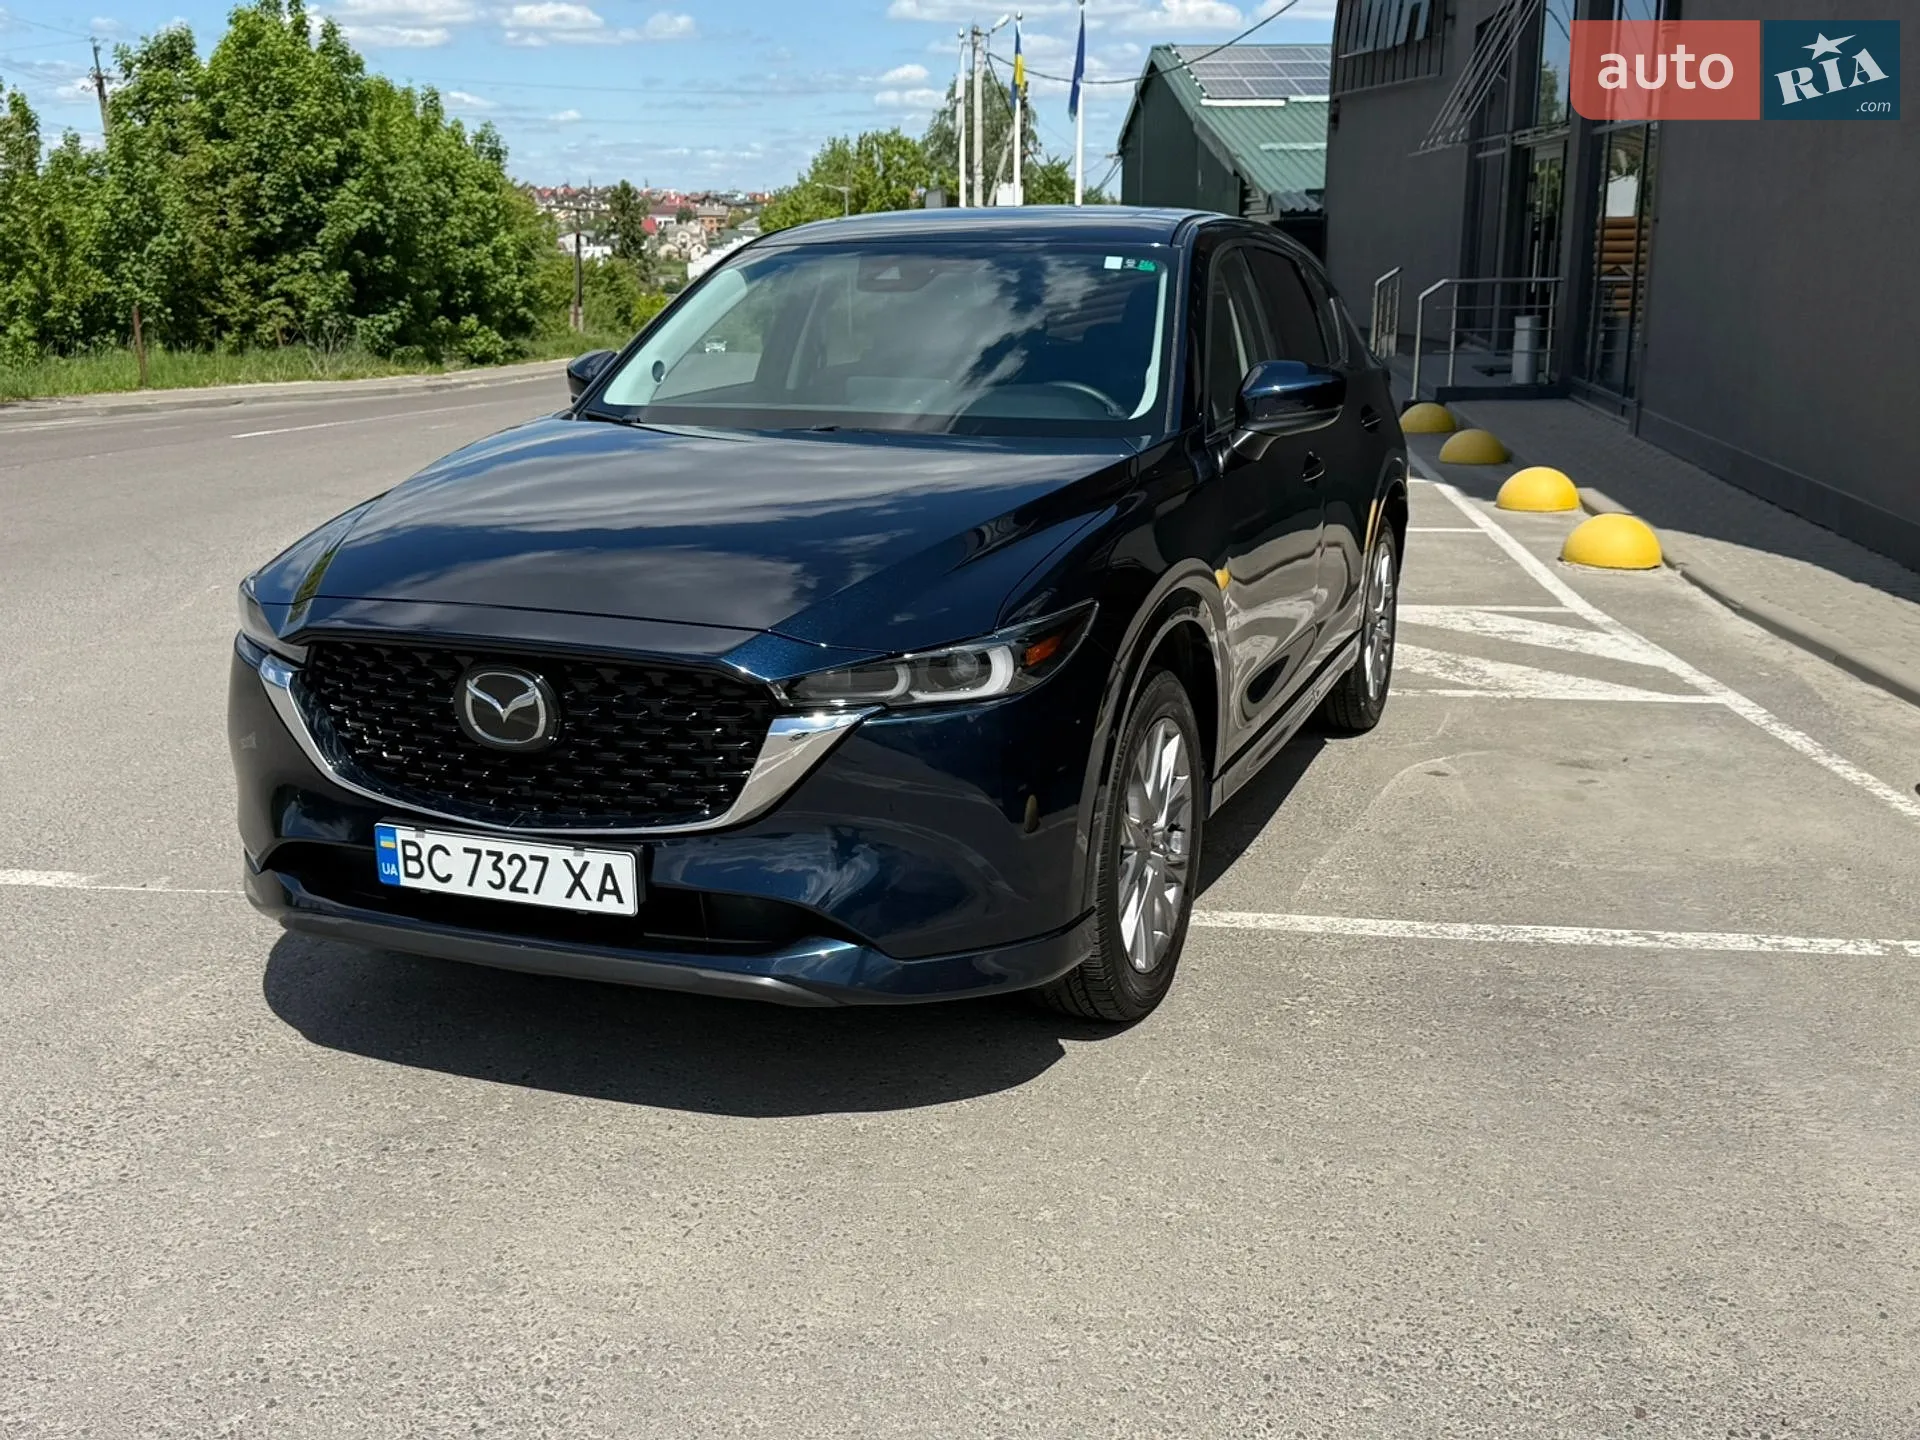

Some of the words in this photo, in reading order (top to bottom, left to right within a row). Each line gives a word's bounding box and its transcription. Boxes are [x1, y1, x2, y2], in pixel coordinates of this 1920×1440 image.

[381, 862, 398, 876] UA
[400, 839, 453, 883] BC
[463, 846, 549, 895] 7327
[562, 858, 624, 904] XA
